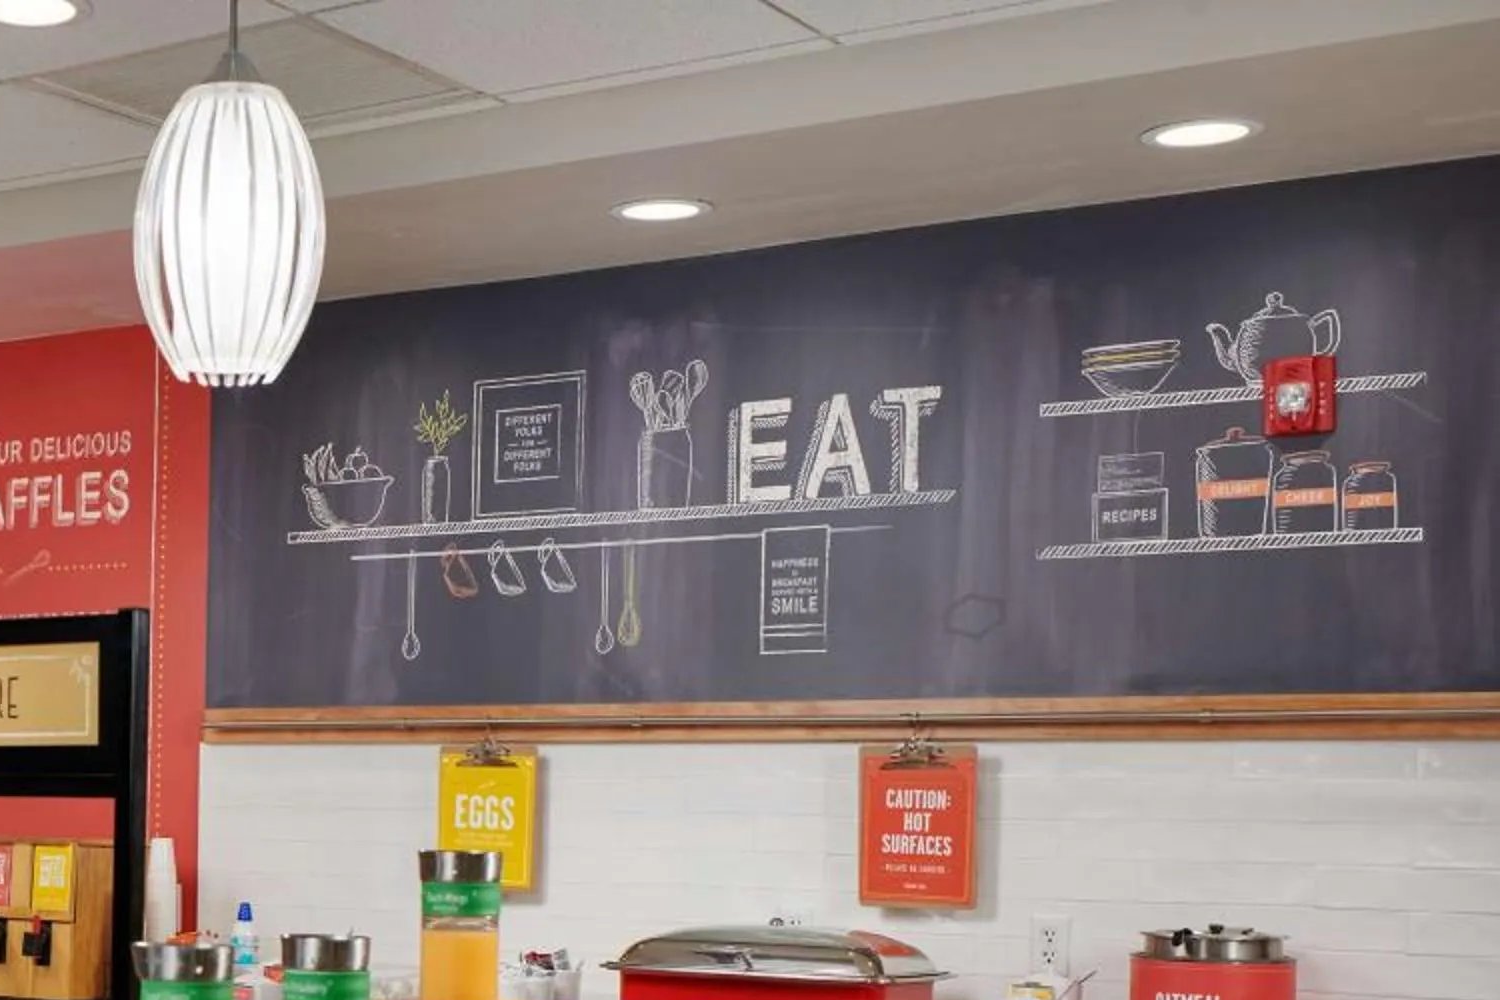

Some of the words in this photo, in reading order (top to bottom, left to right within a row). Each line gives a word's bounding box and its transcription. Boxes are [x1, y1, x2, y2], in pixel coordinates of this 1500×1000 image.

[30, 429, 132, 464] DELICIOUS
[729, 385, 942, 504] EAT
[1102, 508, 1157, 523] RECIPES
[771, 595, 819, 615] SMILE
[886, 788, 952, 810] CAUTION:
[454, 793, 515, 831] EGGS
[903, 812, 932, 832] HOT
[882, 833, 953, 856] SURFACES
